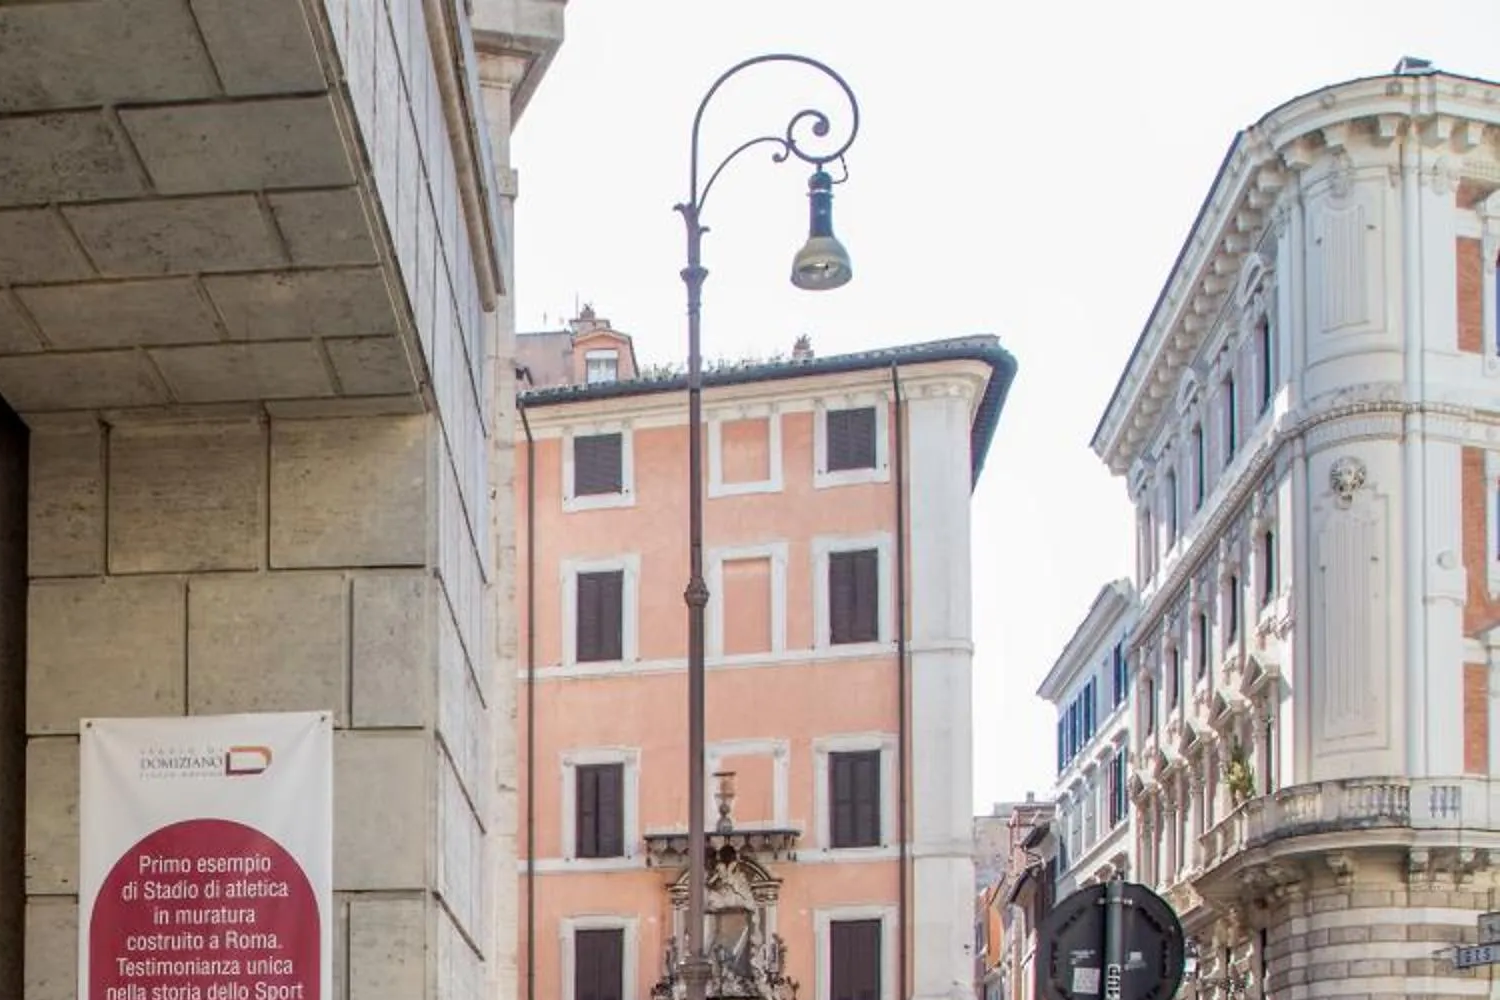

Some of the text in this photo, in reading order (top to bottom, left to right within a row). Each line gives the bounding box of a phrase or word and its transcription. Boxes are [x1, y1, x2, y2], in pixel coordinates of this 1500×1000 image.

[140, 756, 223, 769] DOMIZIANO
[138, 853, 271, 877] Primo esempio
[121, 879, 289, 901] di Stadio di atletica
[153, 906, 255, 925] in muratura
[127, 931, 283, 951] costruito a Roma.
[116, 956, 293, 976] Testimonianza unica
[151, 983, 200, 1000] storia
[206, 982, 249, 1000] dello
